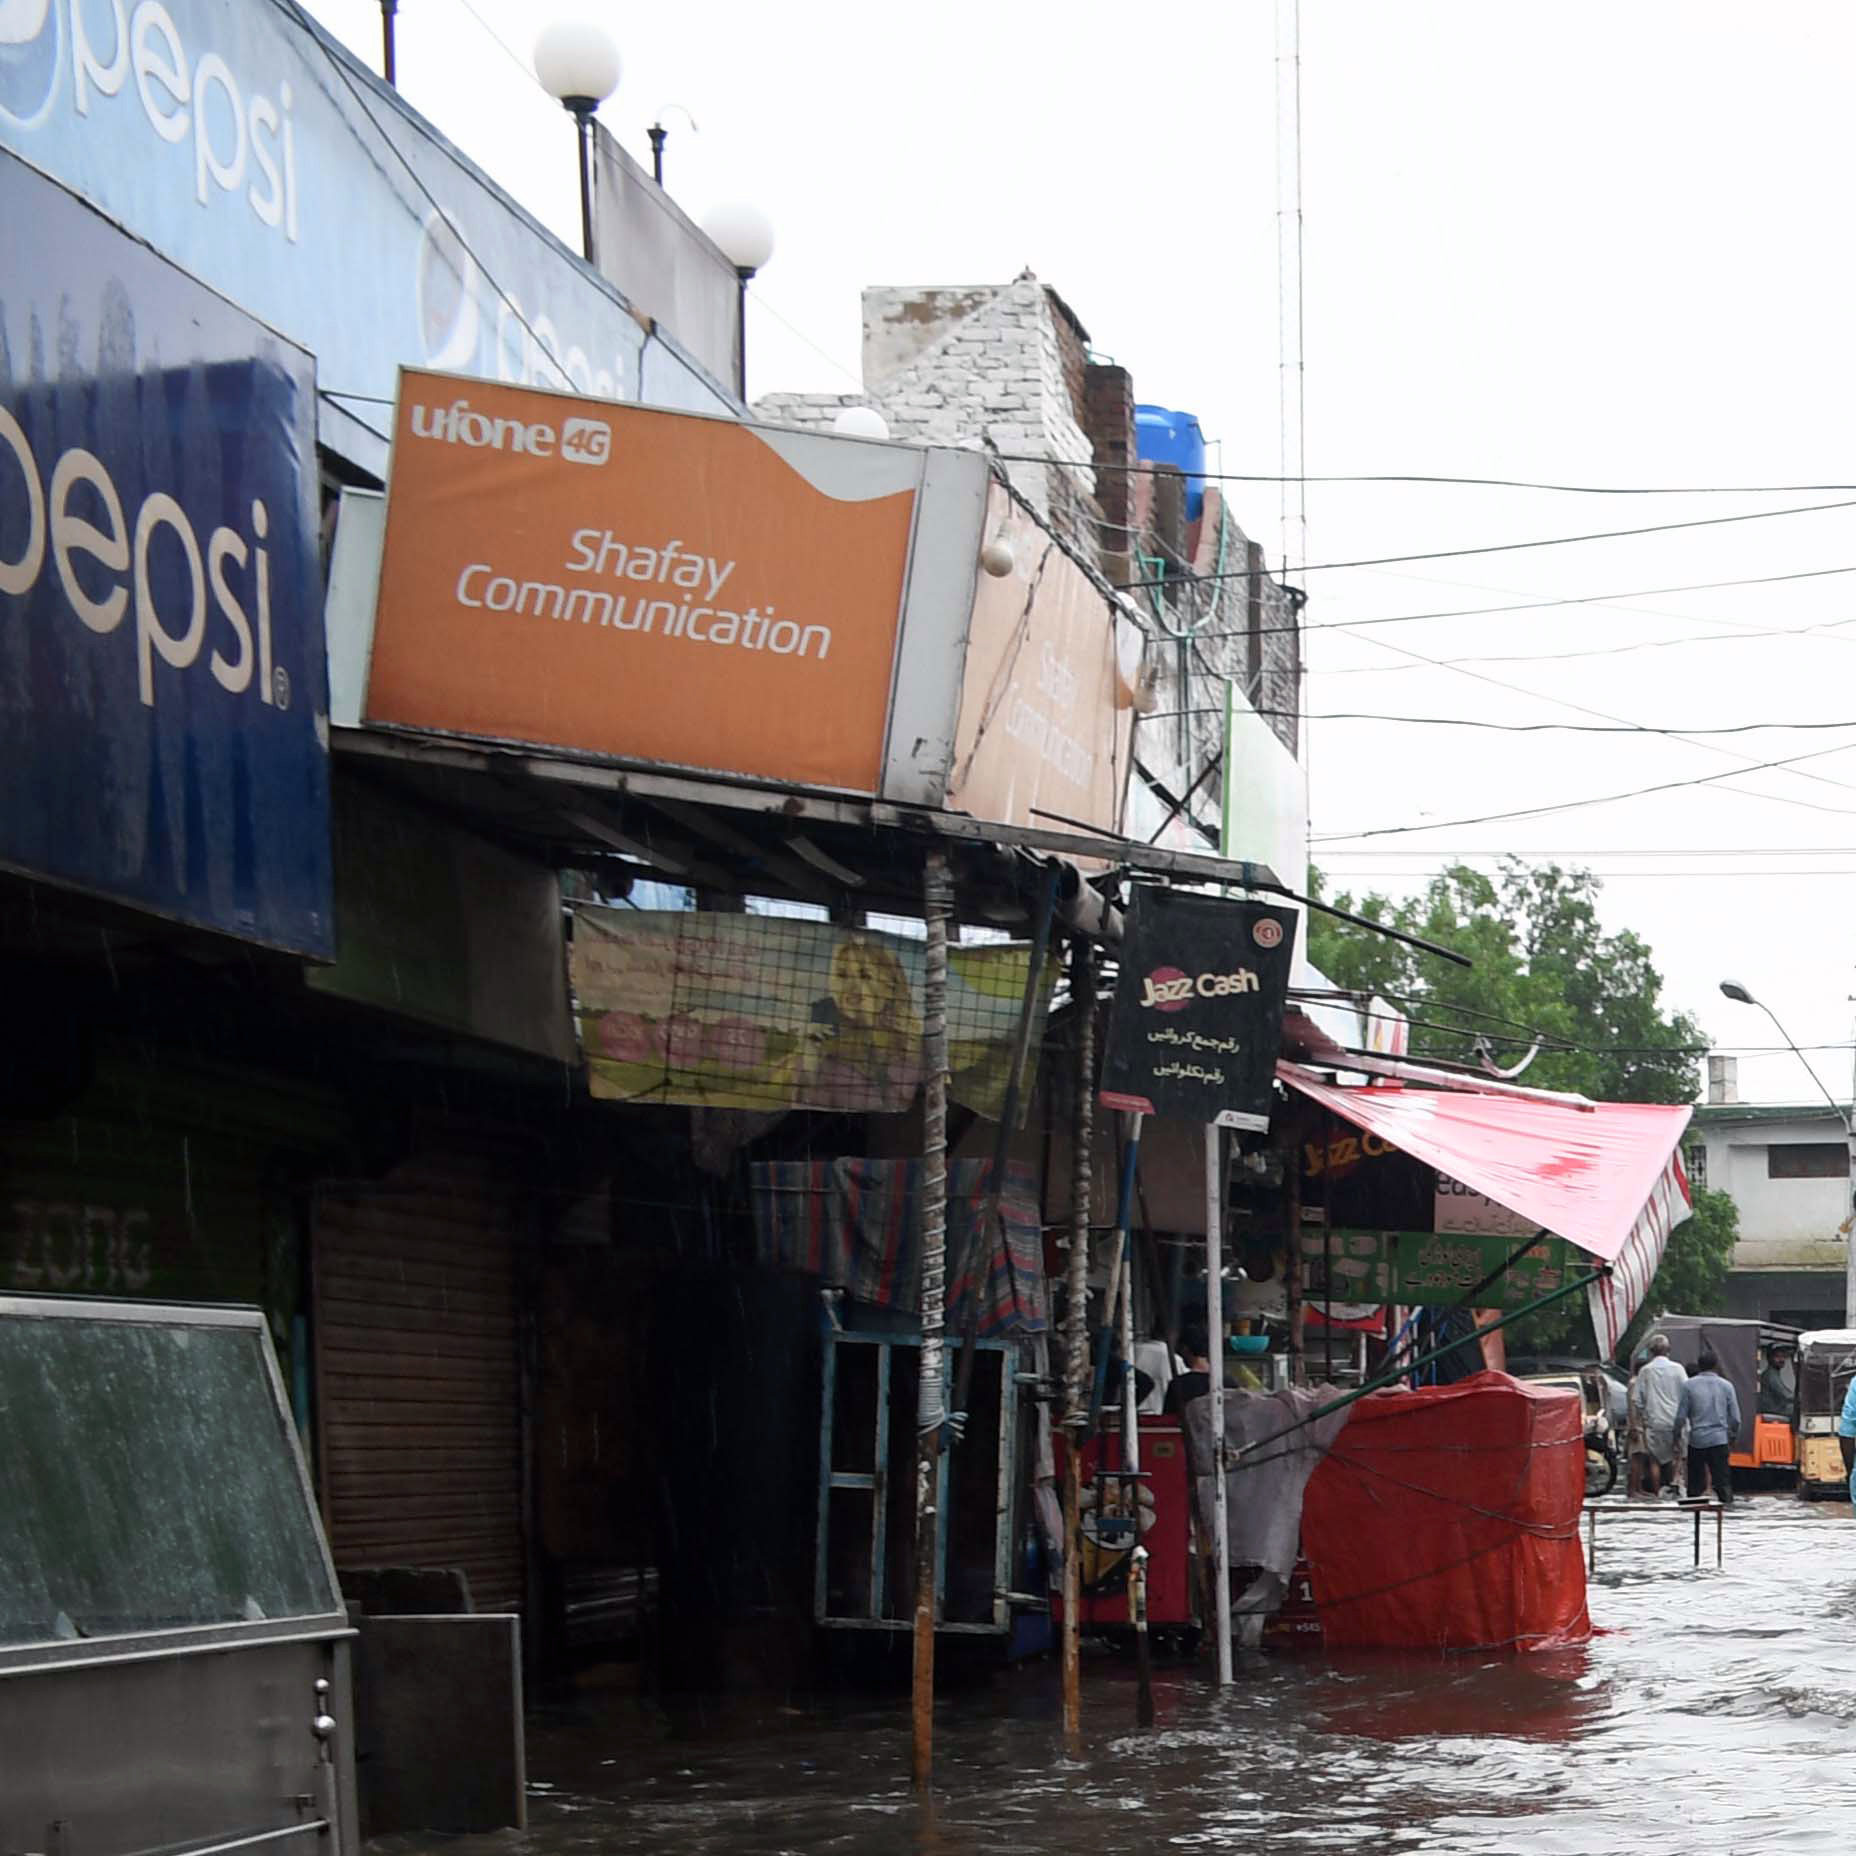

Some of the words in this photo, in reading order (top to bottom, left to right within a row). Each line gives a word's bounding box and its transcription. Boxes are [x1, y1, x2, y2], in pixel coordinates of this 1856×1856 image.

[410, 400, 557, 457] ufone
[565, 427, 606, 457] 4G
[565, 528, 736, 601] Shafay
[456, 563, 832, 660] Communication
